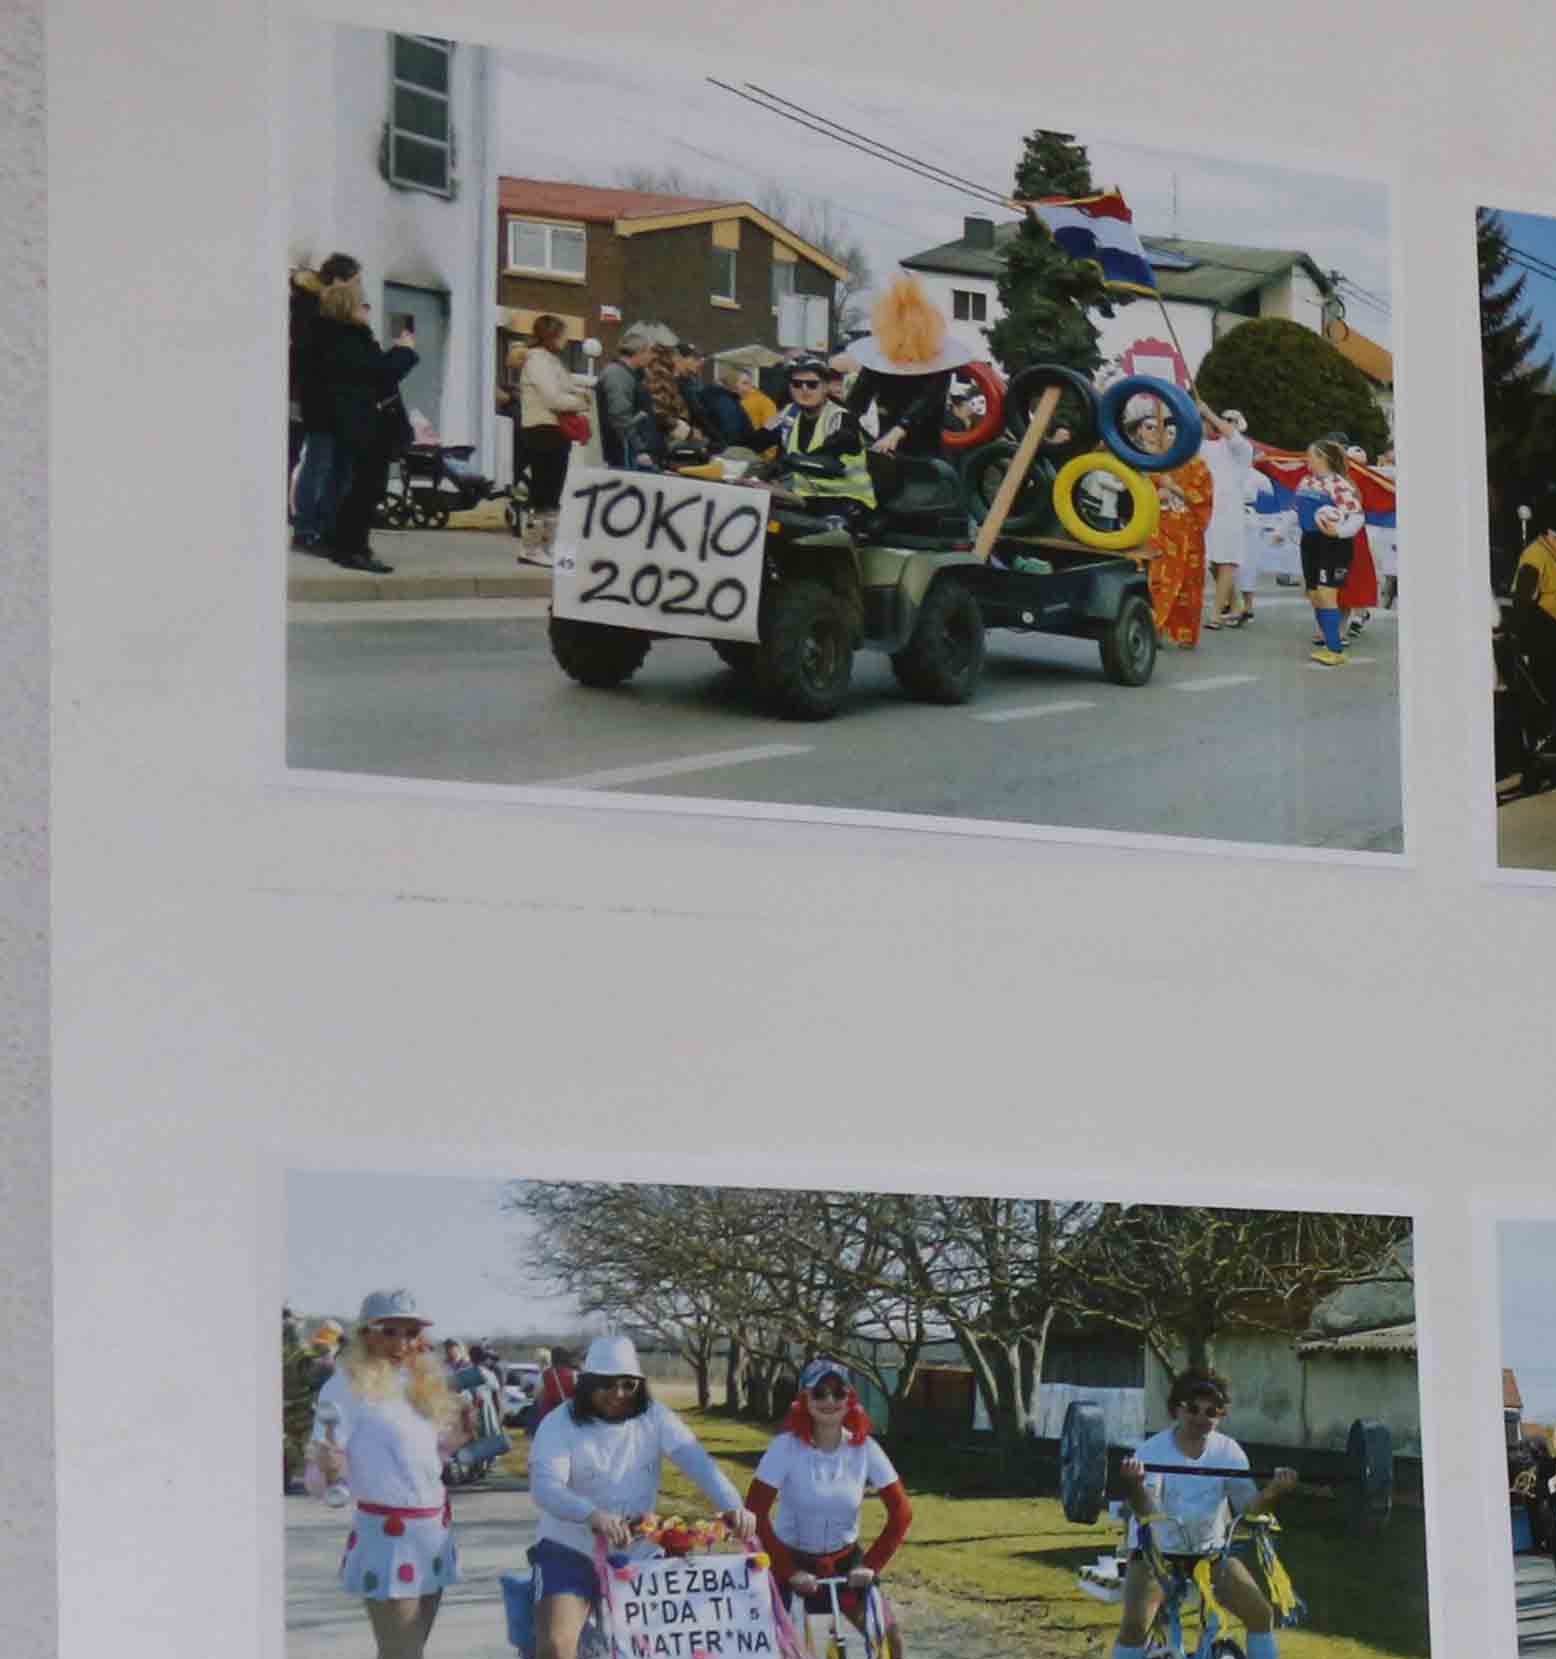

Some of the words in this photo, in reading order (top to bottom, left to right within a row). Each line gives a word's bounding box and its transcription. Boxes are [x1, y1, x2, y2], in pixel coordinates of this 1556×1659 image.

[573, 479, 761, 562] TOKIO
[580, 560, 748, 622] 2020
[630, 1559, 750, 1597] VJEŽBAJ
[708, 1596, 734, 1621] TI
